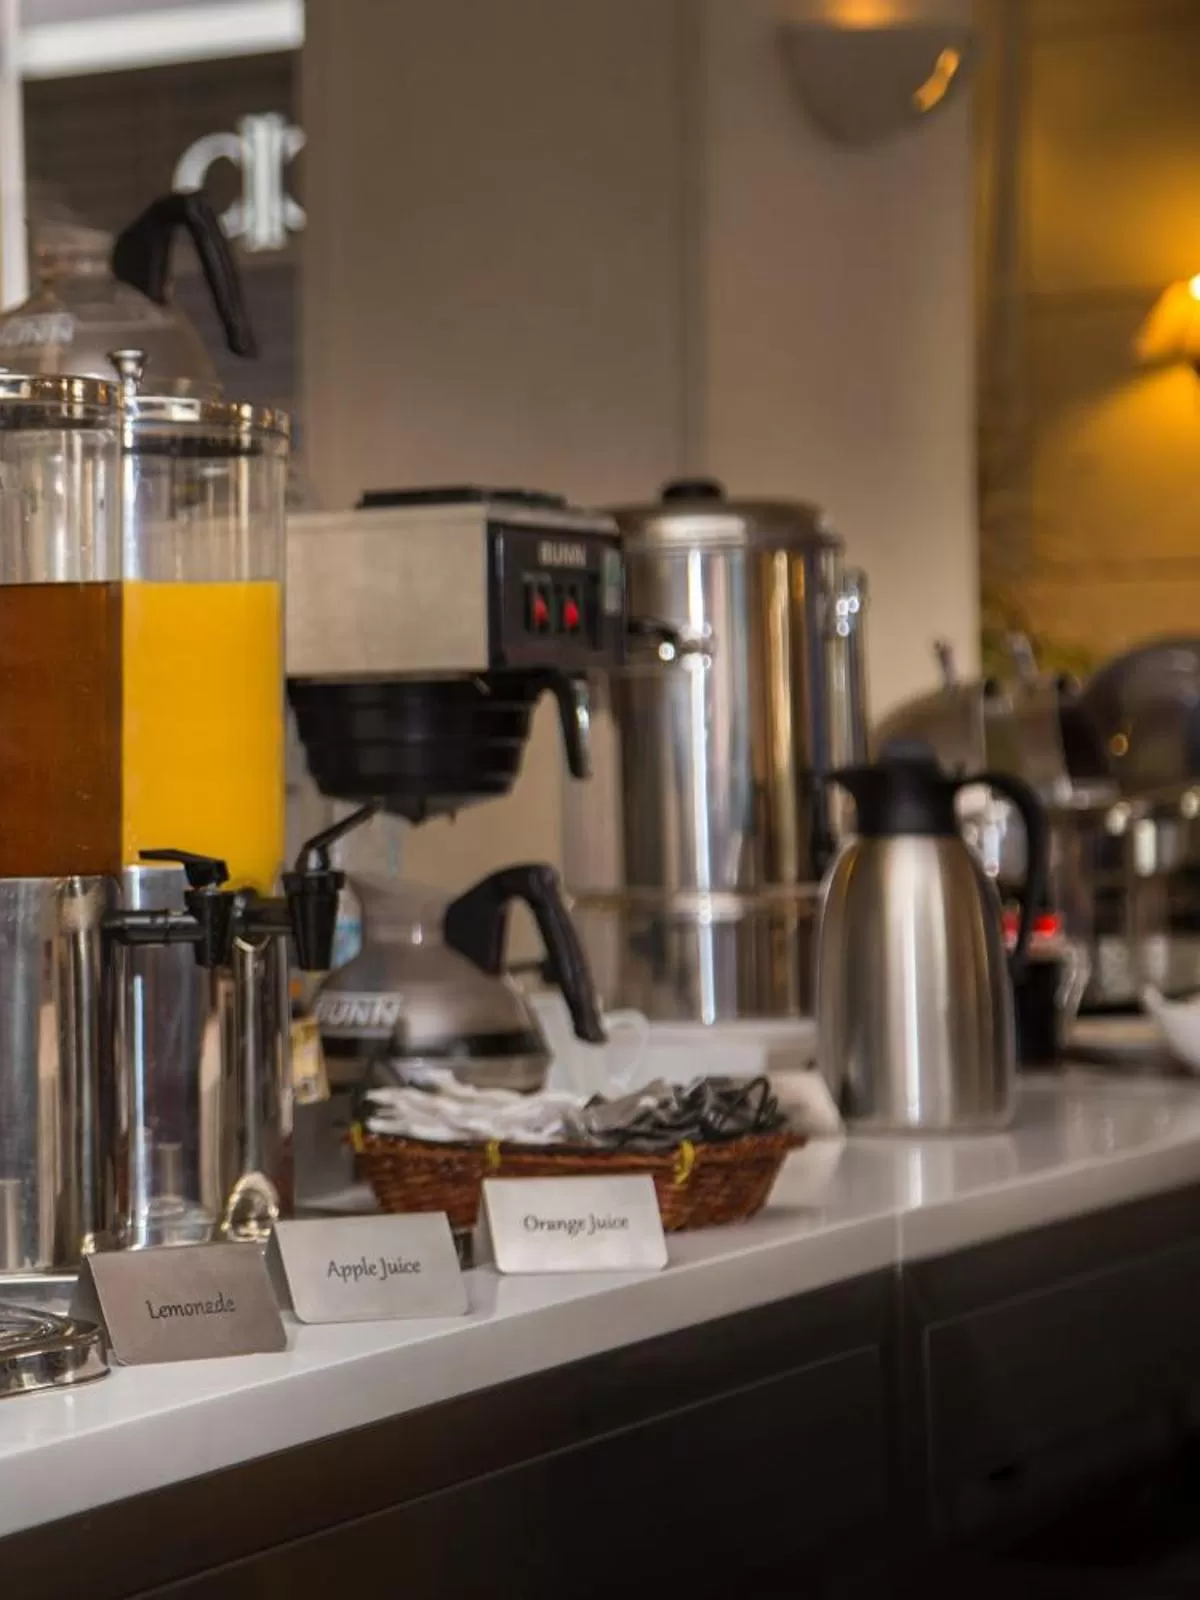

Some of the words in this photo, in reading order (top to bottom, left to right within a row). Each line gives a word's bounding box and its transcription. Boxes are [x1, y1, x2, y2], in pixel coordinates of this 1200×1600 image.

[523, 1214, 585, 1237] Orange
[587, 1212, 629, 1236] Juice
[327, 1256, 377, 1284] Apple
[379, 1255, 422, 1281] Juice
[145, 1292, 236, 1320] Lemonade
